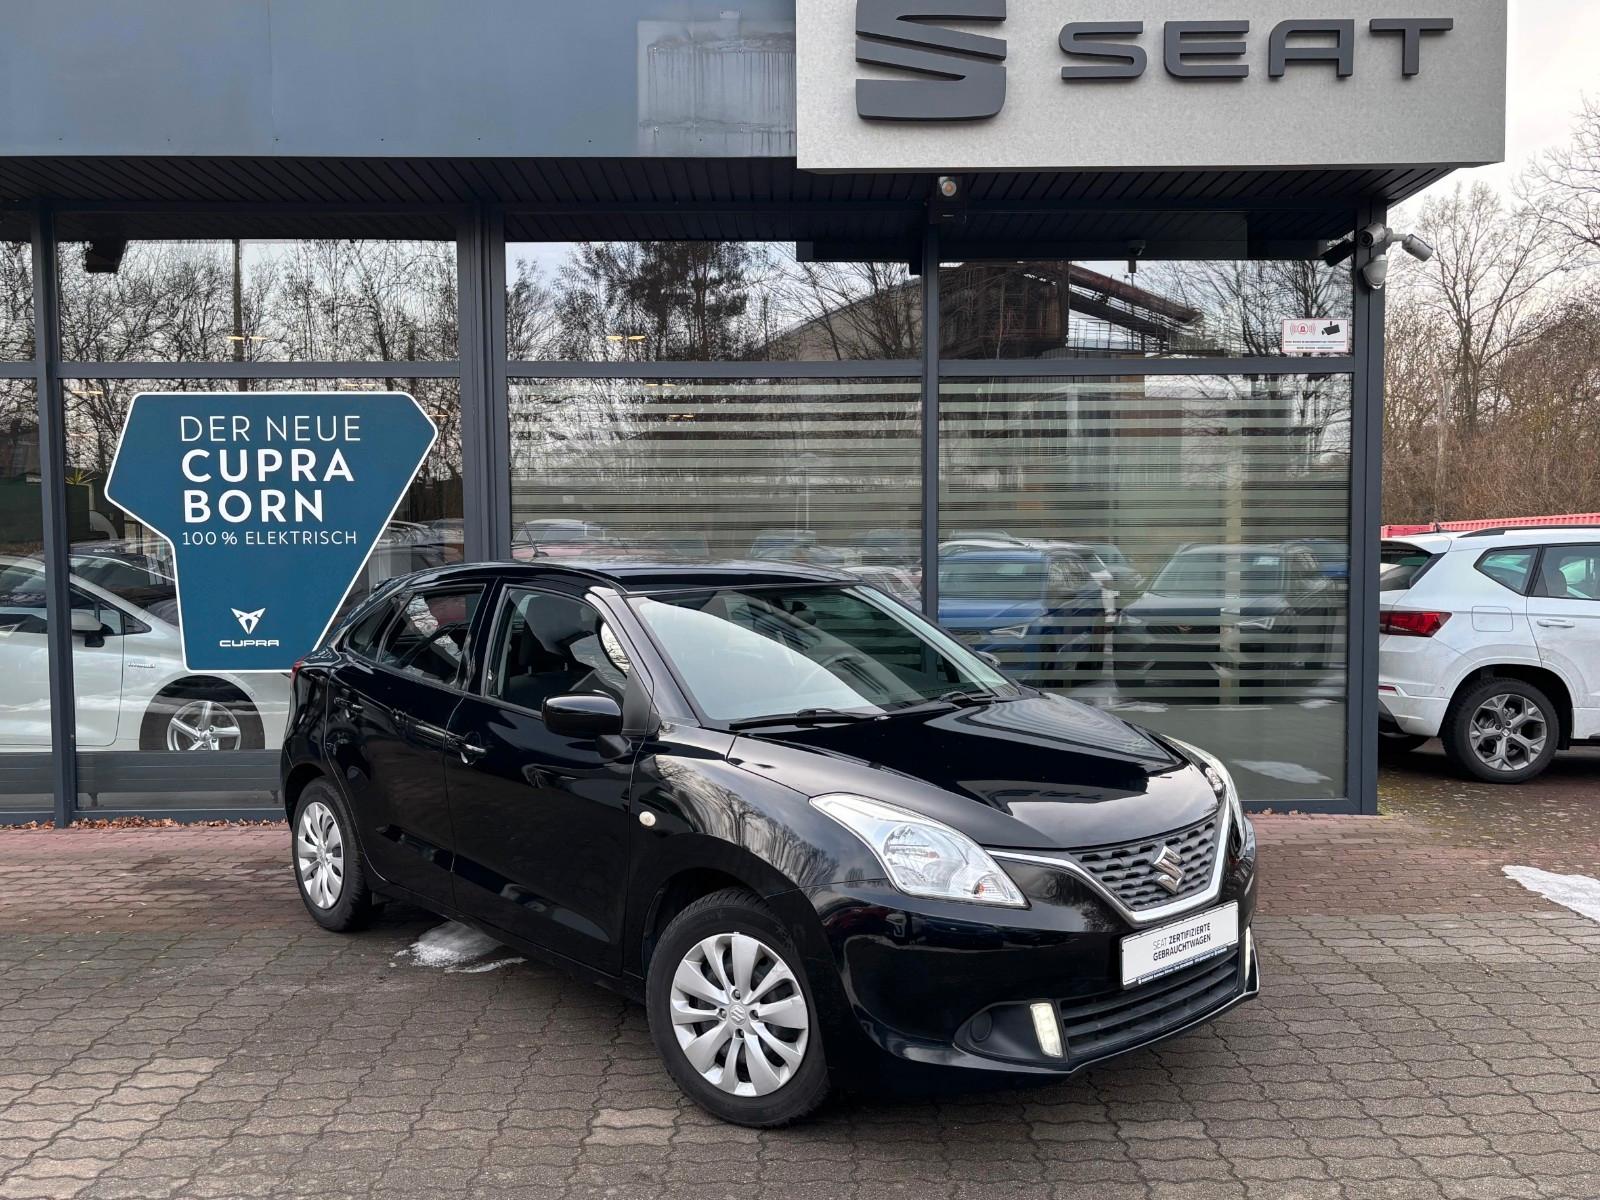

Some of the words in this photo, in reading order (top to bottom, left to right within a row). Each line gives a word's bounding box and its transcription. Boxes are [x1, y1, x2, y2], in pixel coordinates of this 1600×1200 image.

[1058, 18, 1453, 80] SEAT
[180, 416, 250, 442] DER
[266, 416, 361, 442] NEUE
[181, 448, 355, 483] CUPRA
[184, 489, 323, 523] BORN
[182, 531, 216, 545] 100
[245, 530, 358, 545] ELEKTRISCH
[219, 639, 280, 648] CUPRA
[1152, 933, 1211, 961] GEBRAUCHTWAGEN
[1153, 938, 1167, 950] SEAT
[1168, 922, 1211, 945] ZERTIFIZIERTE
